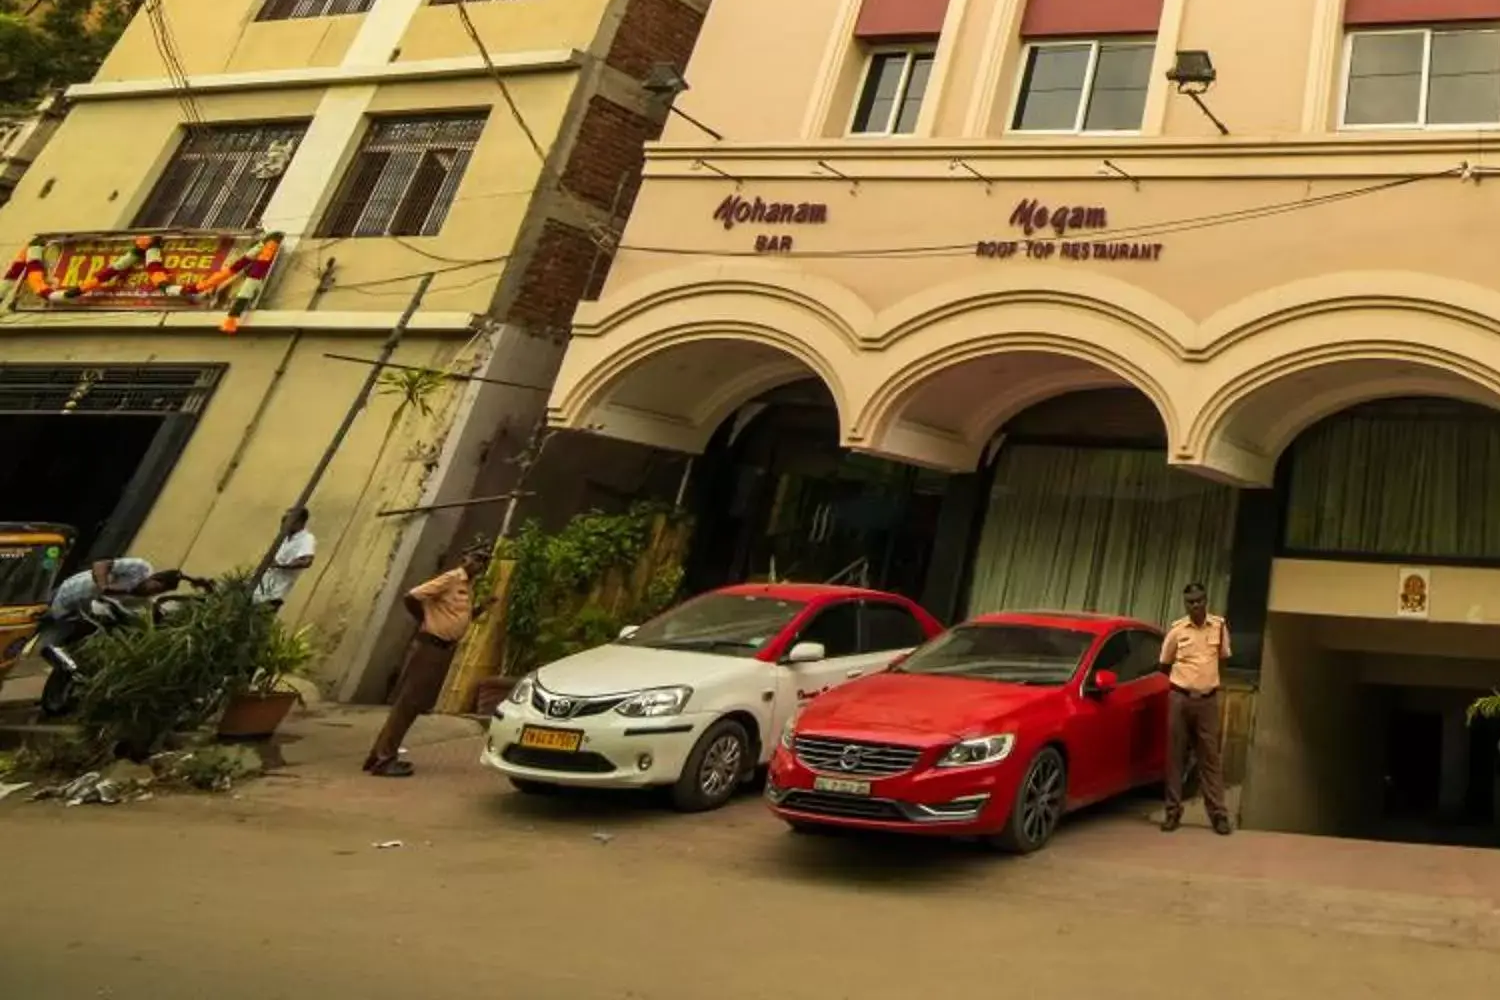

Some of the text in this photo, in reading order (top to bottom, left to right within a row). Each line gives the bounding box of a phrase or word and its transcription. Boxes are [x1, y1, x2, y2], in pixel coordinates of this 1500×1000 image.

[713, 194, 827, 230] Mohanam
[1009, 198, 1107, 236] Megam
[754, 235, 793, 252] BAR
[976, 240, 1163, 261] ROOF TOP RESTAURANT
